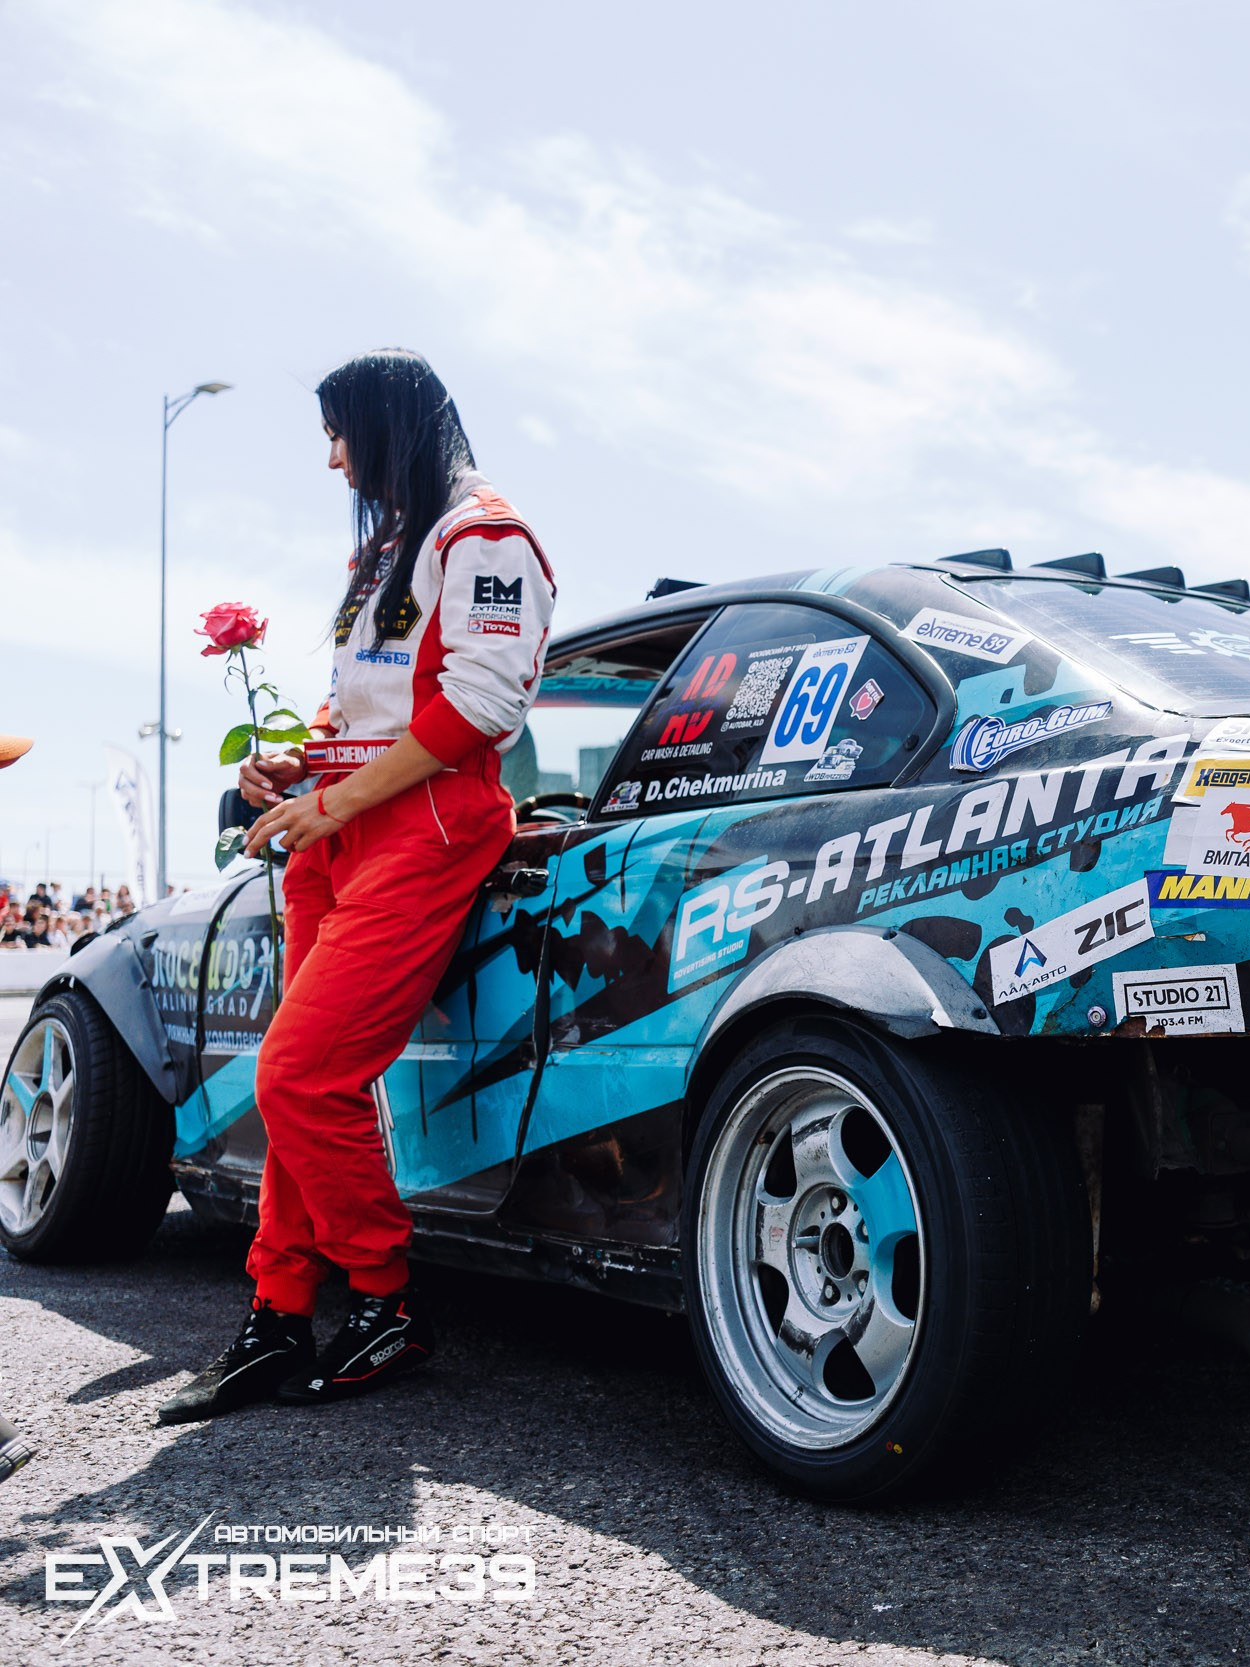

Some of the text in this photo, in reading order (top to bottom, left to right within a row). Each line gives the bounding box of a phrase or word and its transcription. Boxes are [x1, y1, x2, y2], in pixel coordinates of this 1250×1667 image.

[473, 575, 523, 605] EM
[468, 613, 520, 622] MOTORSPORT
[471, 605, 521, 615] EXTREME
[482, 623, 520, 634] TOTAL
[983, 635, 1010, 653] 39
[395, 653, 408, 664] 39
[772, 662, 849, 748] 69
[641, 748, 656, 761] CAR
[655, 747, 673, 758] WASH
[679, 742, 713, 756] DETAILING
[644, 767, 787, 802] D.Chekmurina
[676, 733, 1190, 961] RS-ATLANTA
[857, 796, 1164, 914] РЕКЛАМНАЯ СТУДИЯ
[1074, 898, 1146, 955] ZIC
[673, 939, 745, 981] ADVERTISING STUDIO
[1133, 985, 1221, 1007] STUDIO 21
[1156, 1015, 1204, 1027] 103.4 FM
[370, 1337, 406, 1366] sparco
